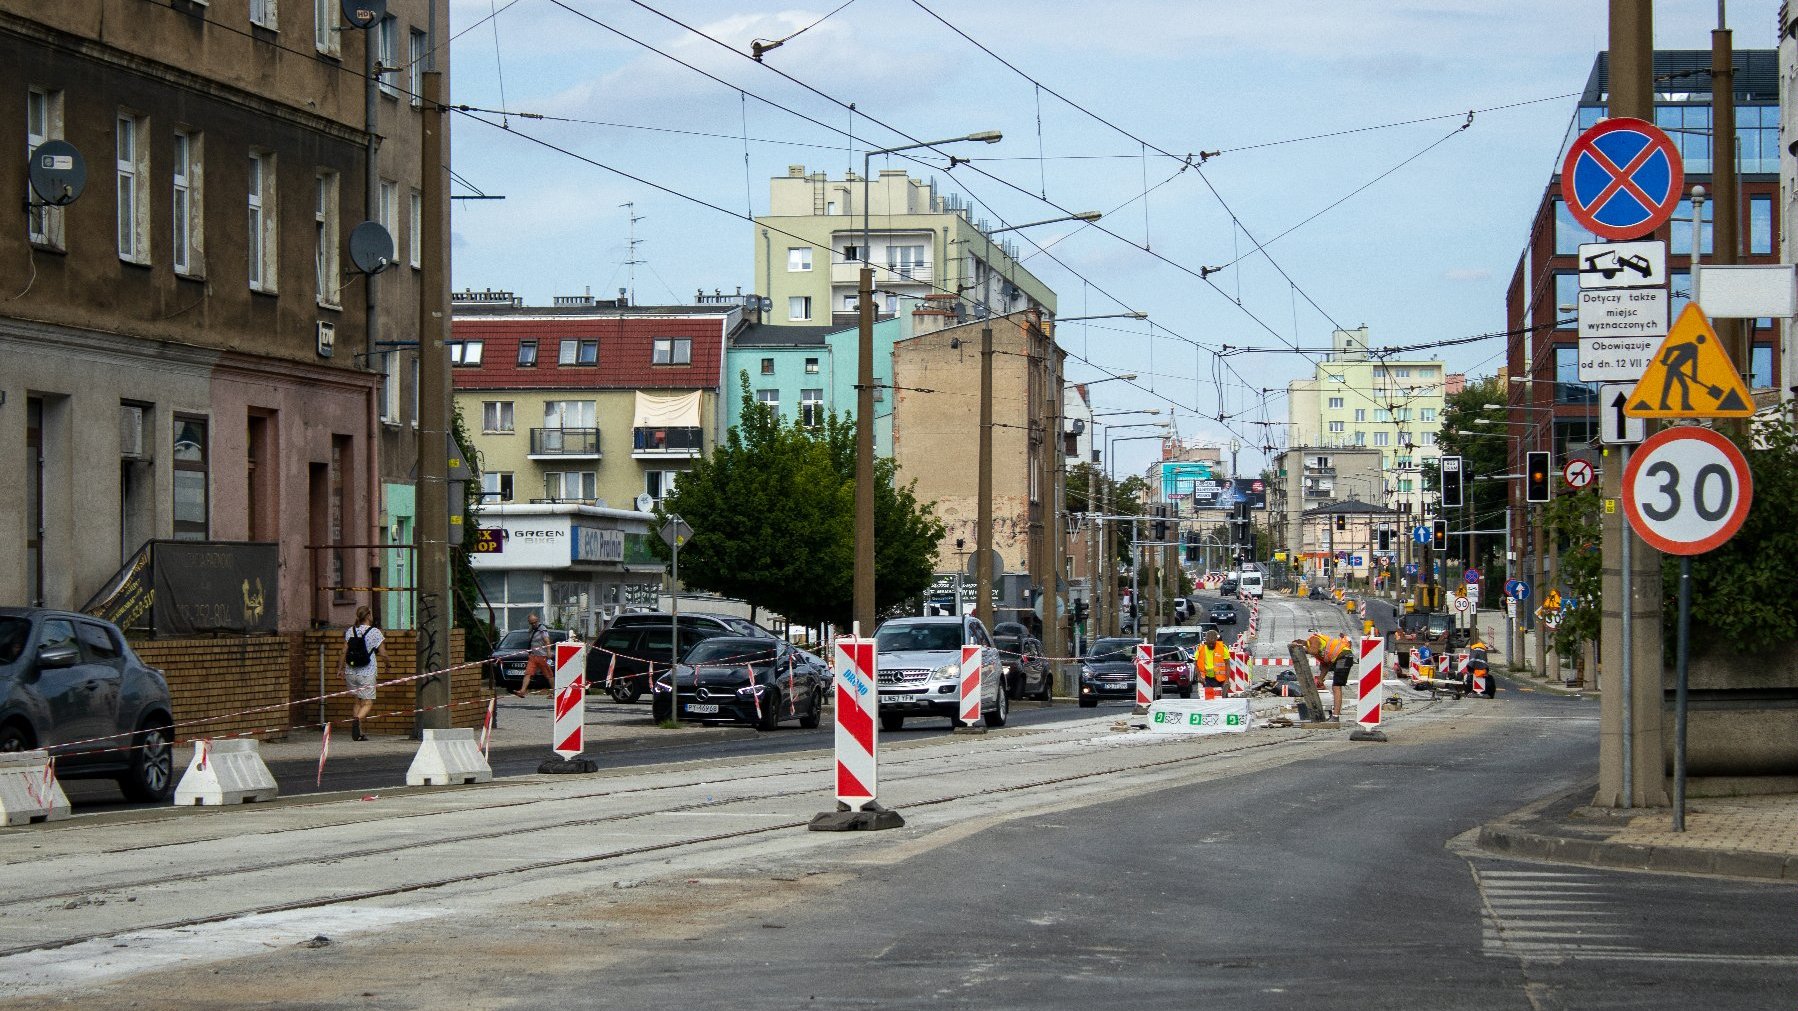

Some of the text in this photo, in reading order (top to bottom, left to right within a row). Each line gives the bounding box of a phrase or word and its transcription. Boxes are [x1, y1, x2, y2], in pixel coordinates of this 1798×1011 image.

[1583, 293, 1657, 304] Dotyczy także
[1606, 308, 1638, 317] miejsc
[1587, 320, 1658, 331] wyznaczonych
[1592, 341, 1651, 351] Obowiązuje
[1581, 360, 1594, 369] od
[1597, 360, 1614, 368] dn.
[1615, 360, 1626, 368] 12
[1629, 359, 1642, 368] VII
[1642, 460, 1732, 522] 30
[514, 530, 565, 538] GREEN
[1456, 600, 1468, 608] 30
